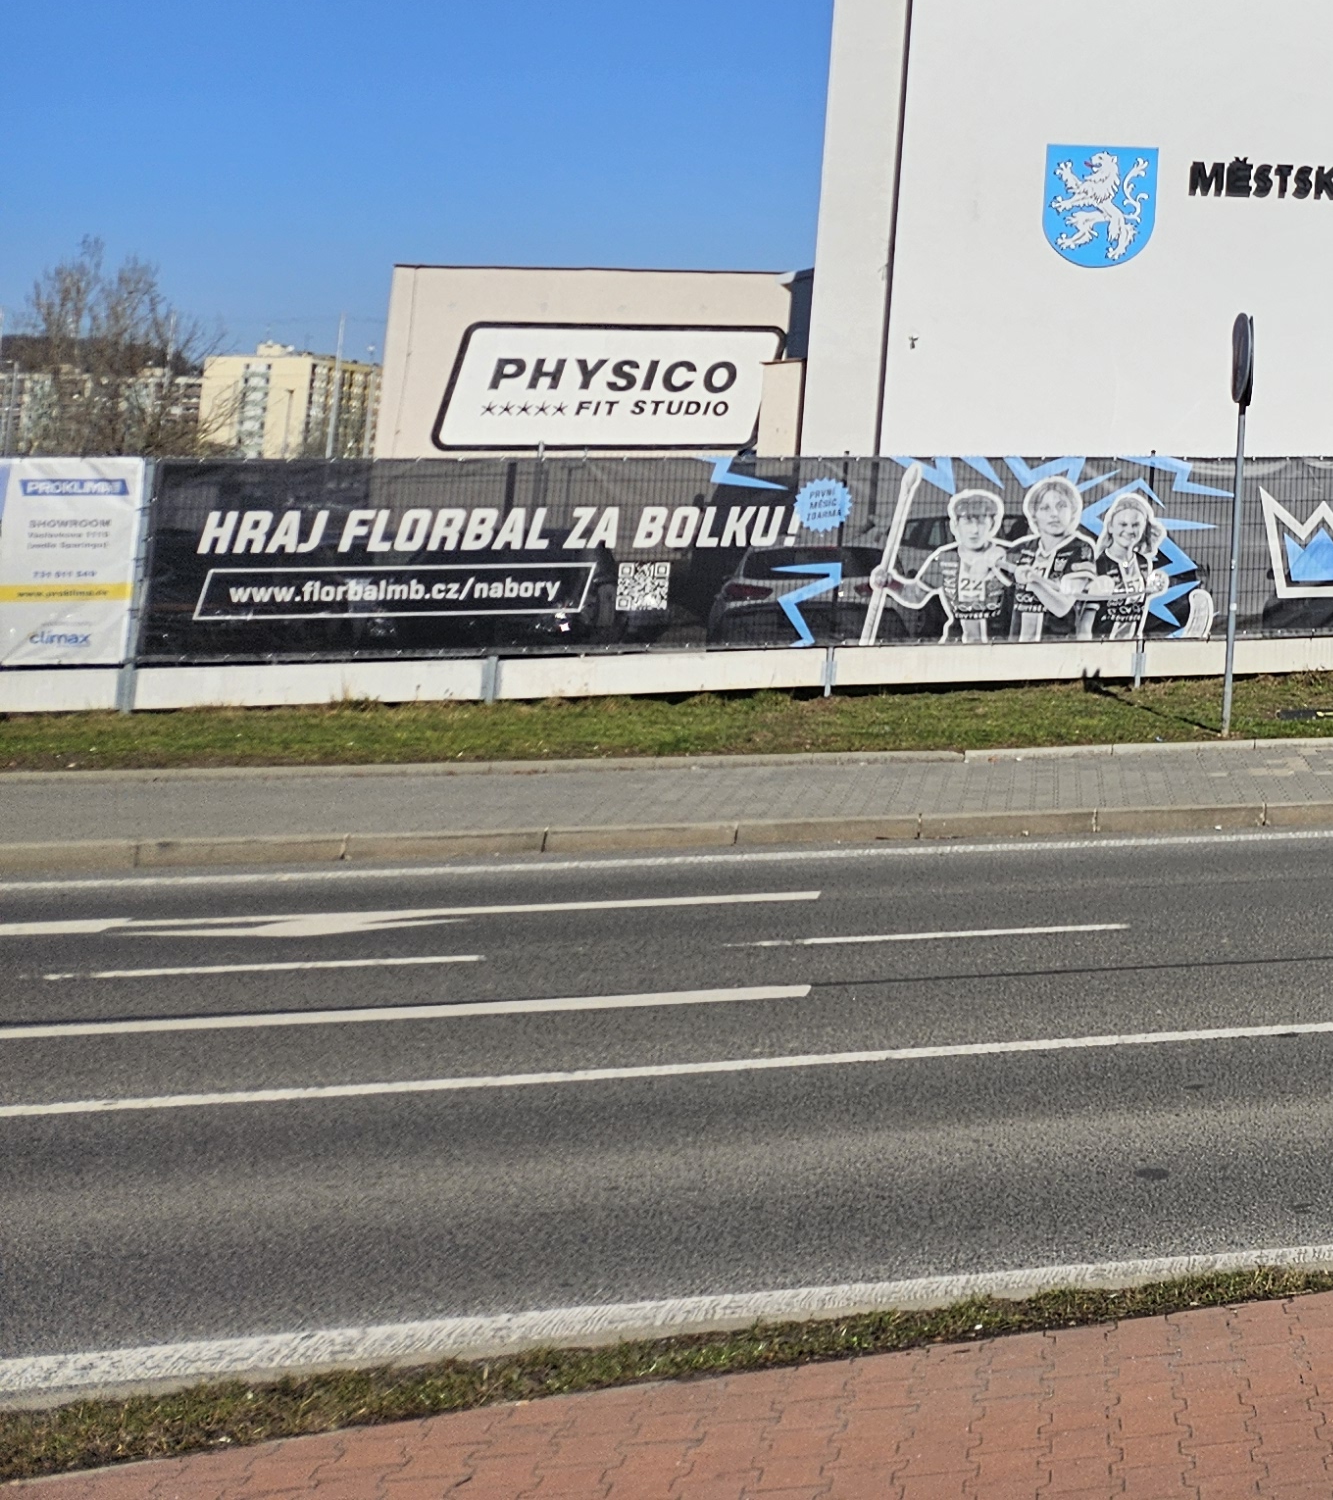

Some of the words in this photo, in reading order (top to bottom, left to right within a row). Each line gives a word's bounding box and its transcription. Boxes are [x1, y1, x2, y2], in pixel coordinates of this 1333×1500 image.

[487, 357, 738, 394] PHYSICO
[574, 400, 619, 416] FIT
[629, 400, 730, 417] STUDIO
[196, 509, 330, 555] HRAJ
[337, 507, 551, 553] FLORBAL
[562, 506, 620, 550] ZA
[631, 505, 802, 549] BOLKU!
[228, 575, 562, 603] www.florbalmb.cz/nabory
[29, 630, 92, 645] climax
